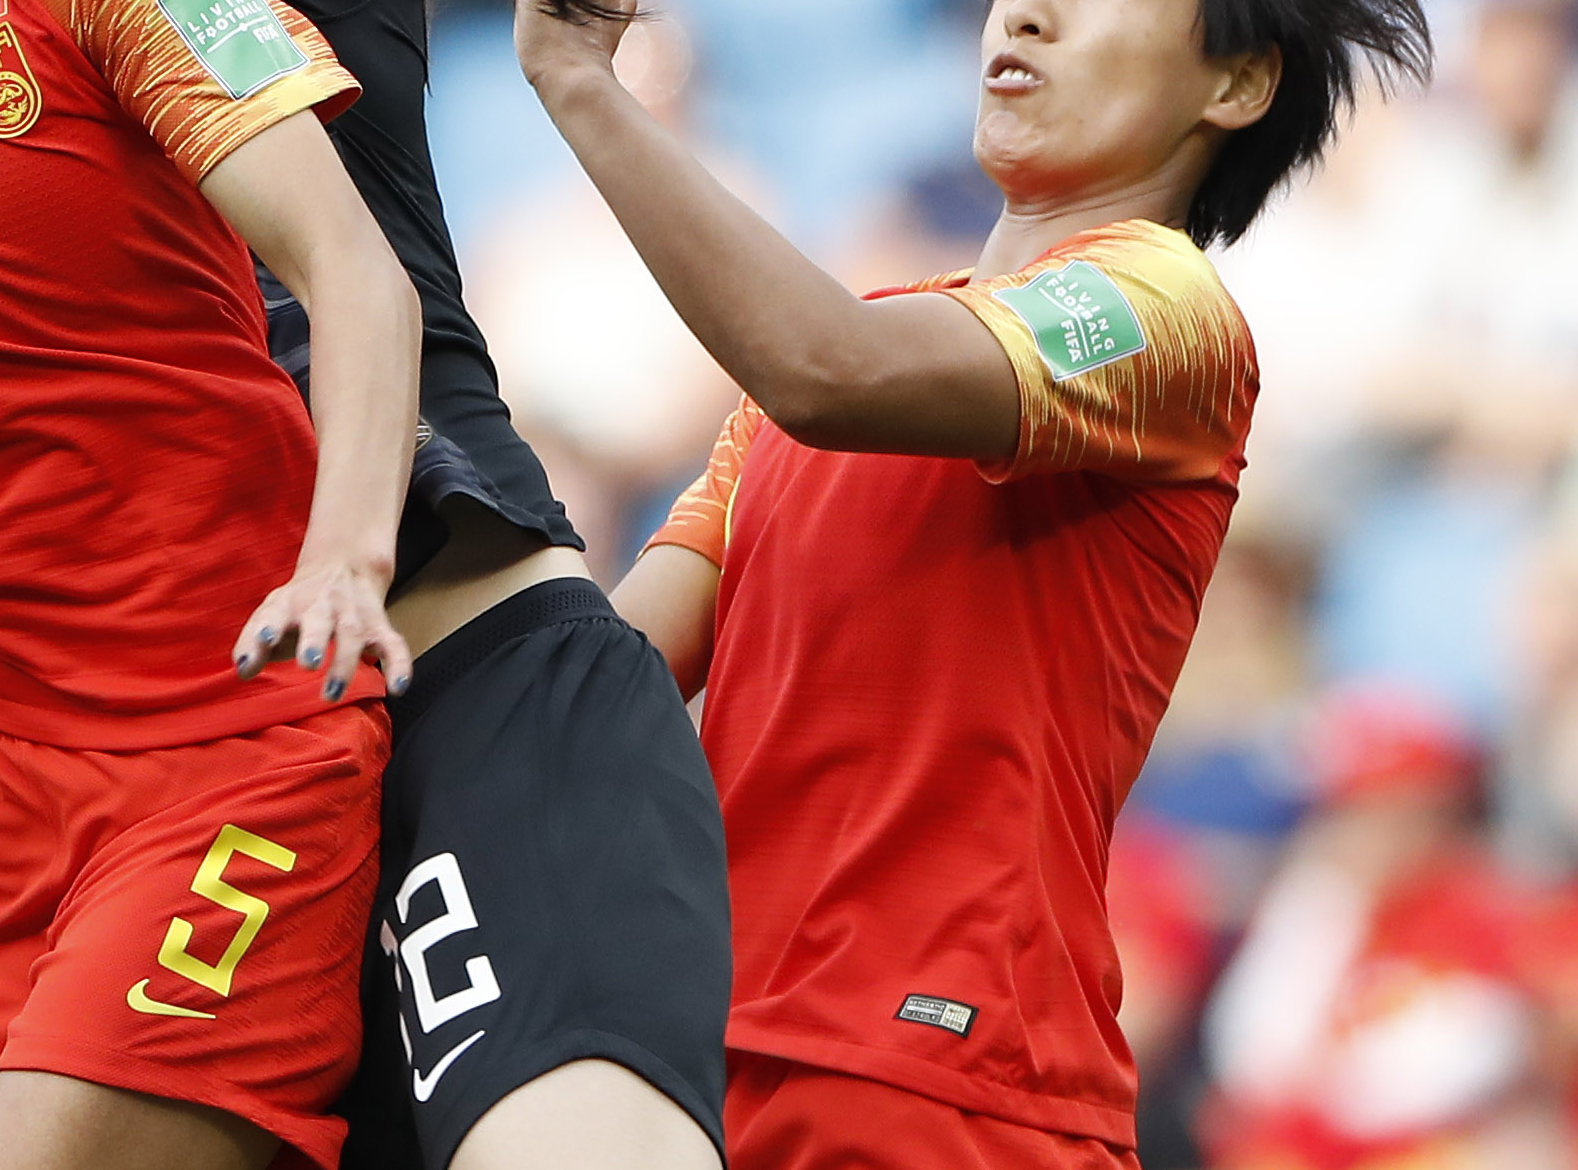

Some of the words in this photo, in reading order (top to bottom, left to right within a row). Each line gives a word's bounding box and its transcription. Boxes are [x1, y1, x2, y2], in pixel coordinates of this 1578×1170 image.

[195, 0, 263, 45] FOOTBALL
[252, 23, 280, 44] FIFA
[1046, 277, 1103, 355] FOOTBALL
[1057, 273, 1115, 351] LIVING
[1060, 319, 1084, 363] FIFA
[158, 823, 297, 997] 5
